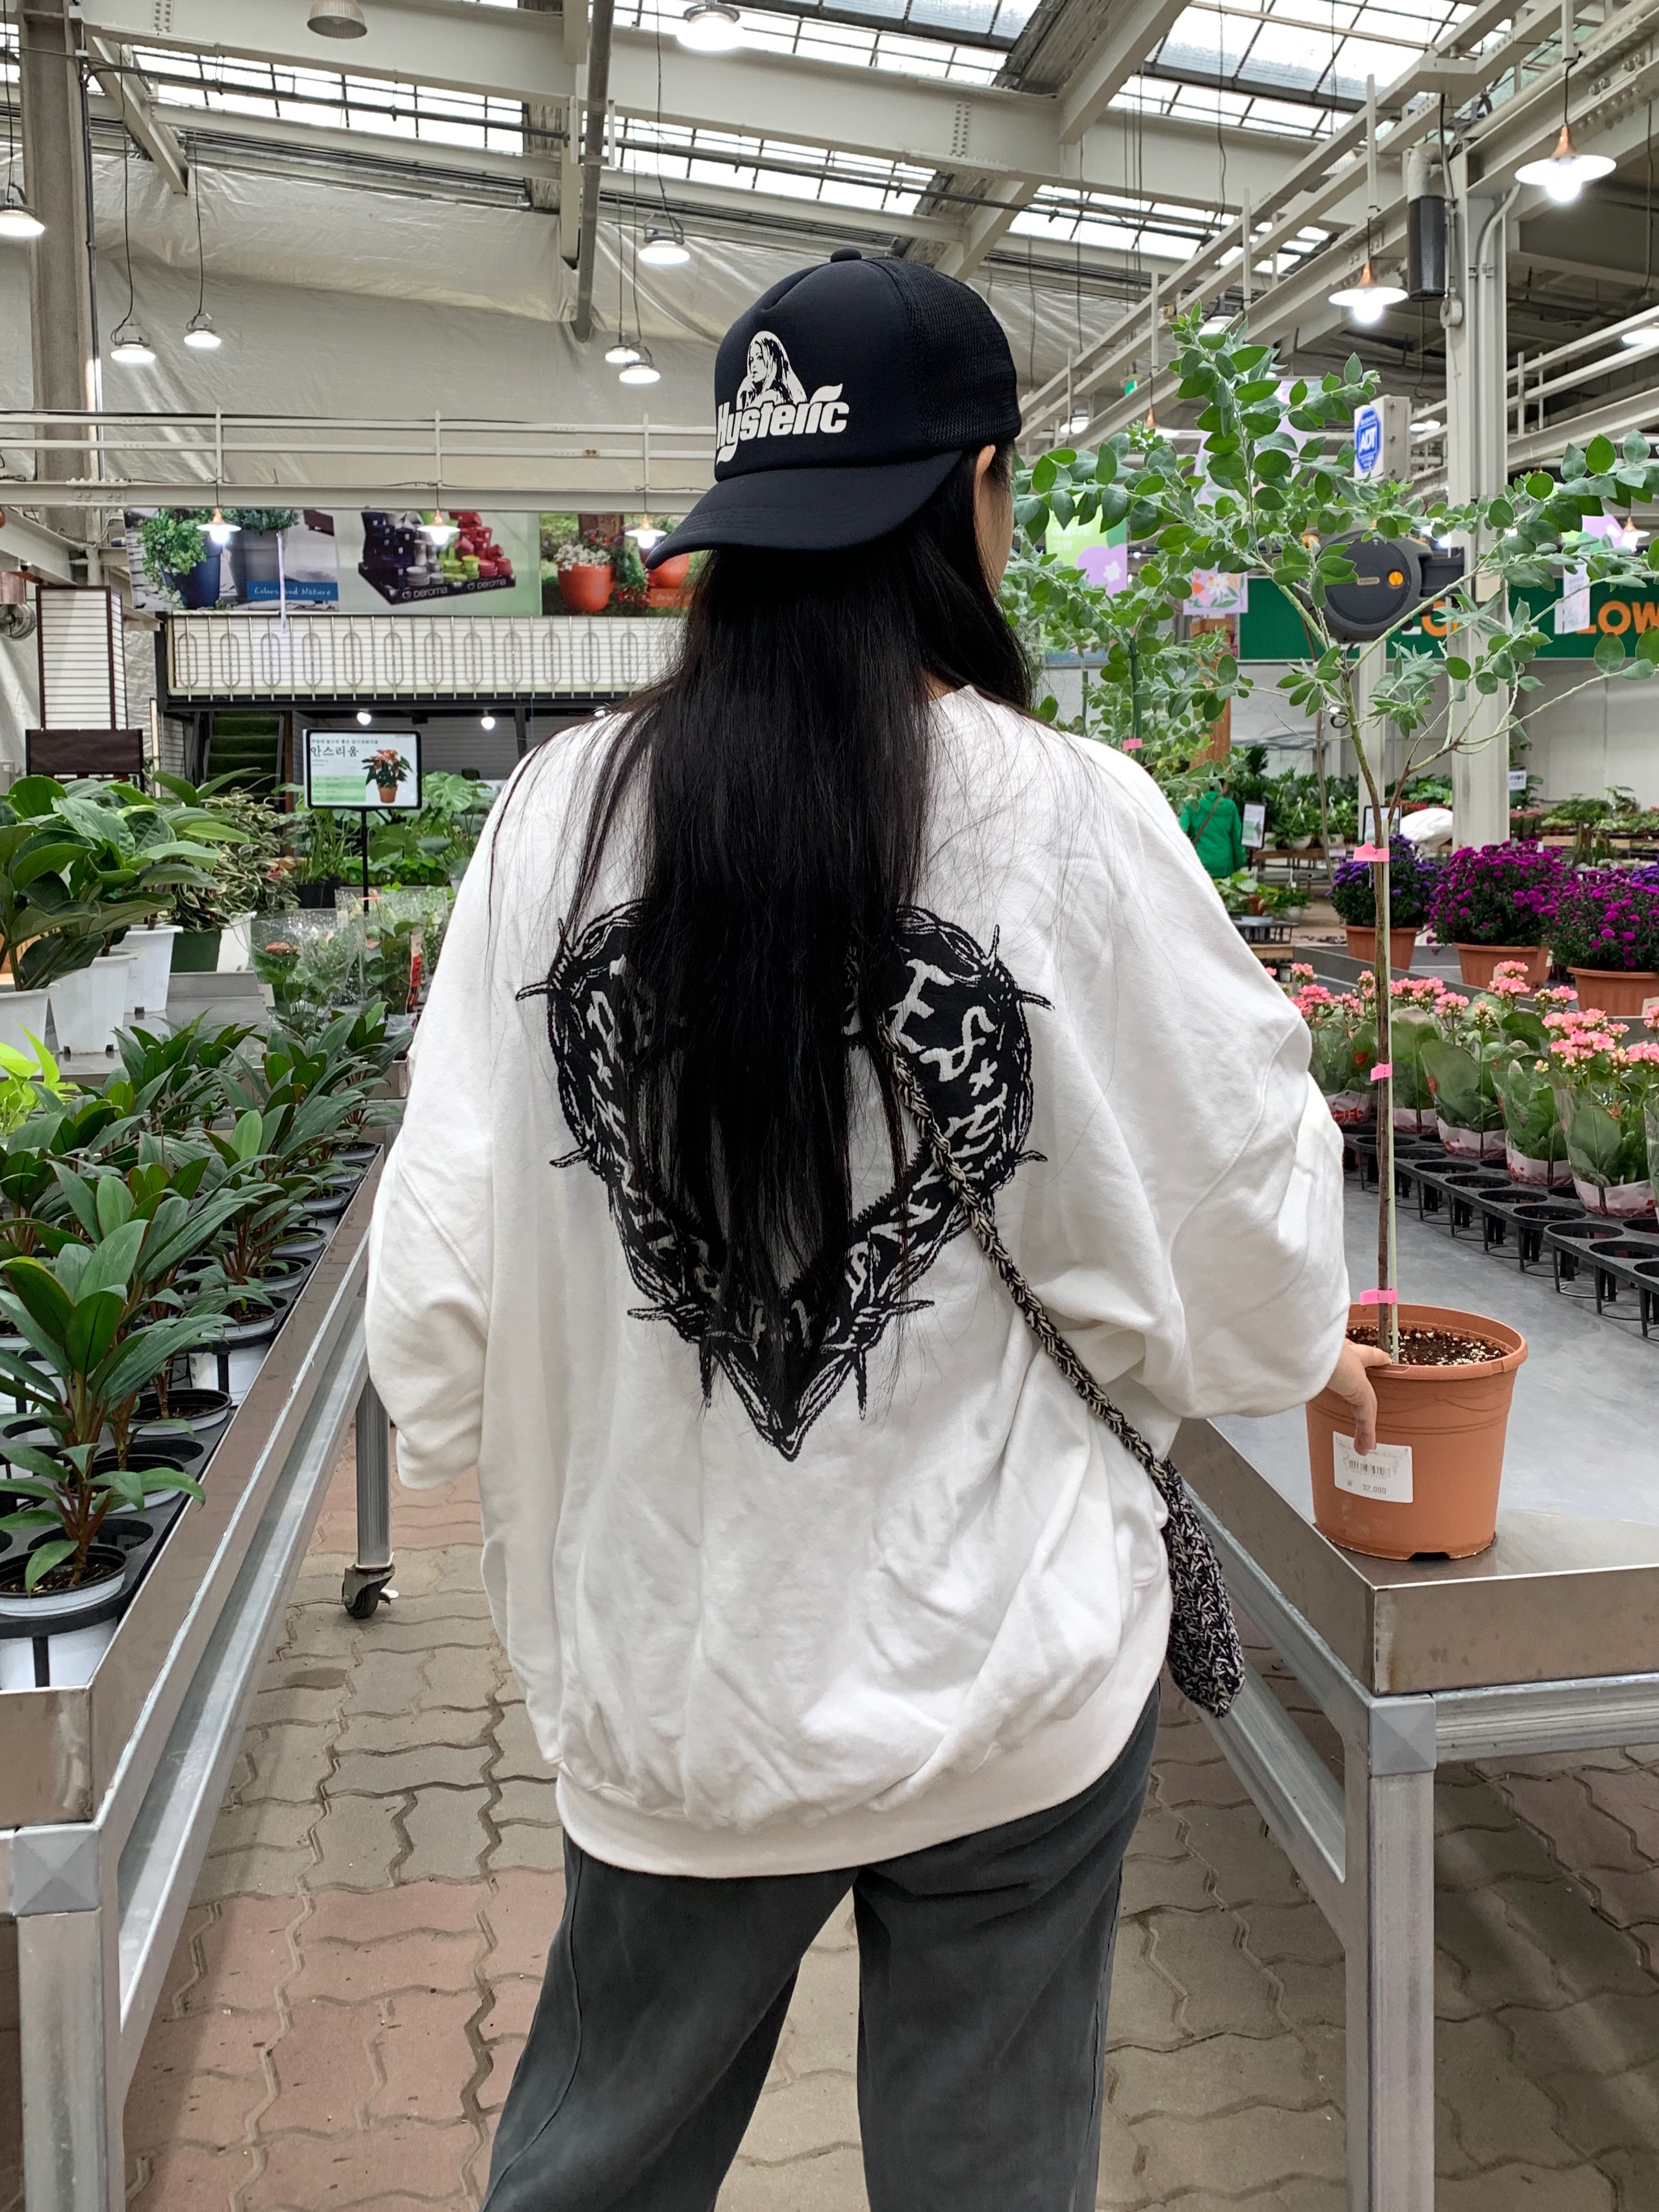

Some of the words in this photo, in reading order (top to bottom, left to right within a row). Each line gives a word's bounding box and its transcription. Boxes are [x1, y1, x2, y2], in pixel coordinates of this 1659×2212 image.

[716, 383, 849, 466] Hysteric
[1359, 426, 1376, 453] ADT
[254, 587, 279, 595] Colors
[301, 587, 331, 596] Nature
[310, 744, 359, 757] 안스리움
